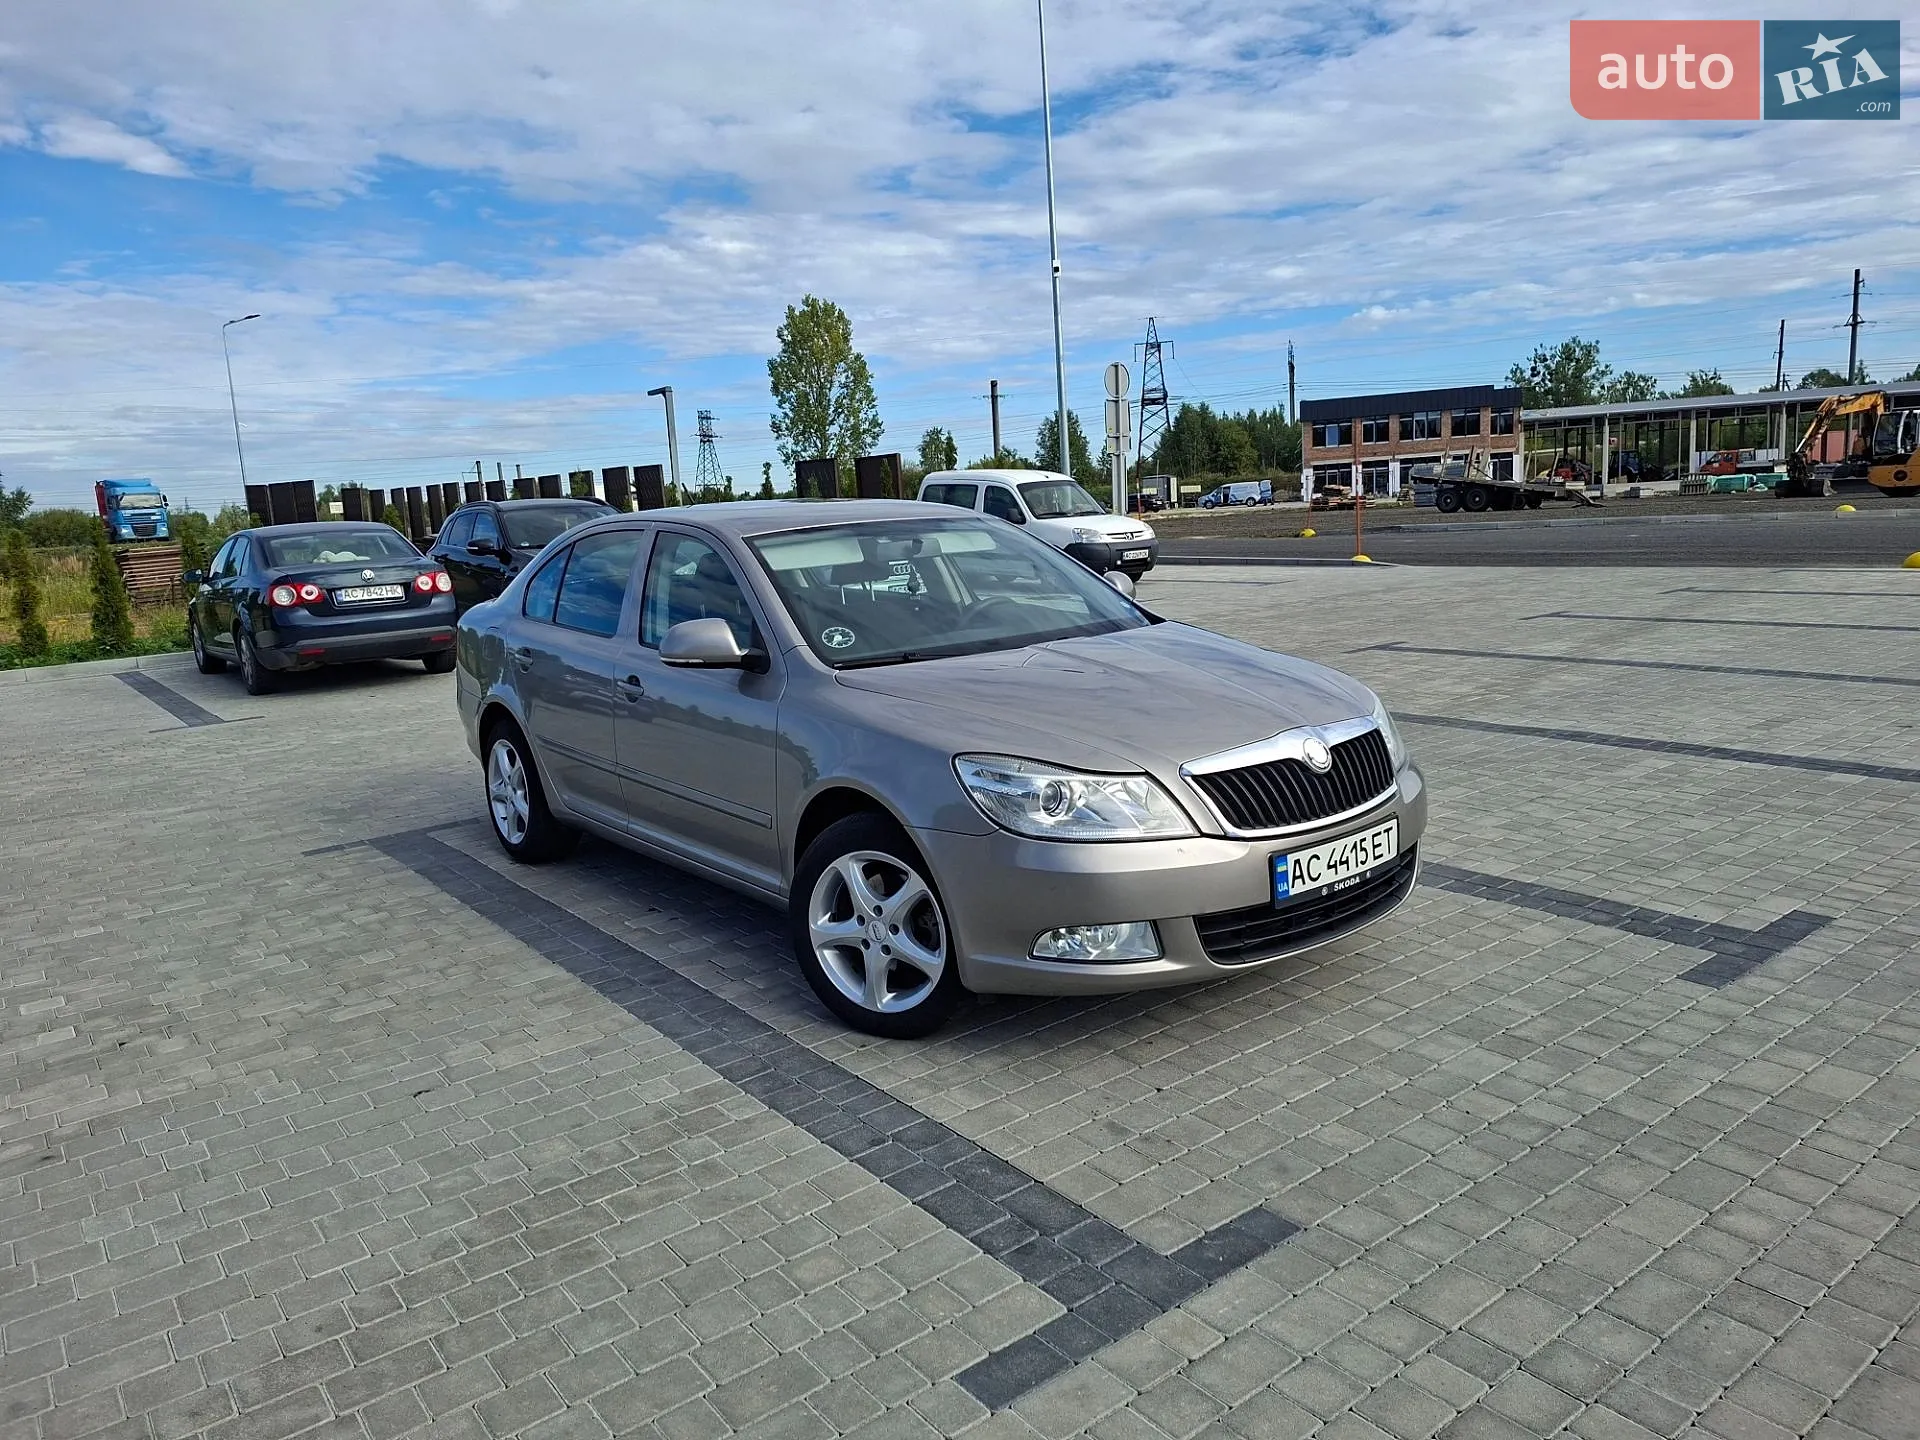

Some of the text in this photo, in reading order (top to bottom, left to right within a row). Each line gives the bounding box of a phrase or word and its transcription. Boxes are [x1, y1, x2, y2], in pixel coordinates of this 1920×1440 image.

[344, 585, 400, 599] AC 7842 HK
[1291, 826, 1393, 888] AC 4415 ET
[1278, 882, 1288, 892] UA
